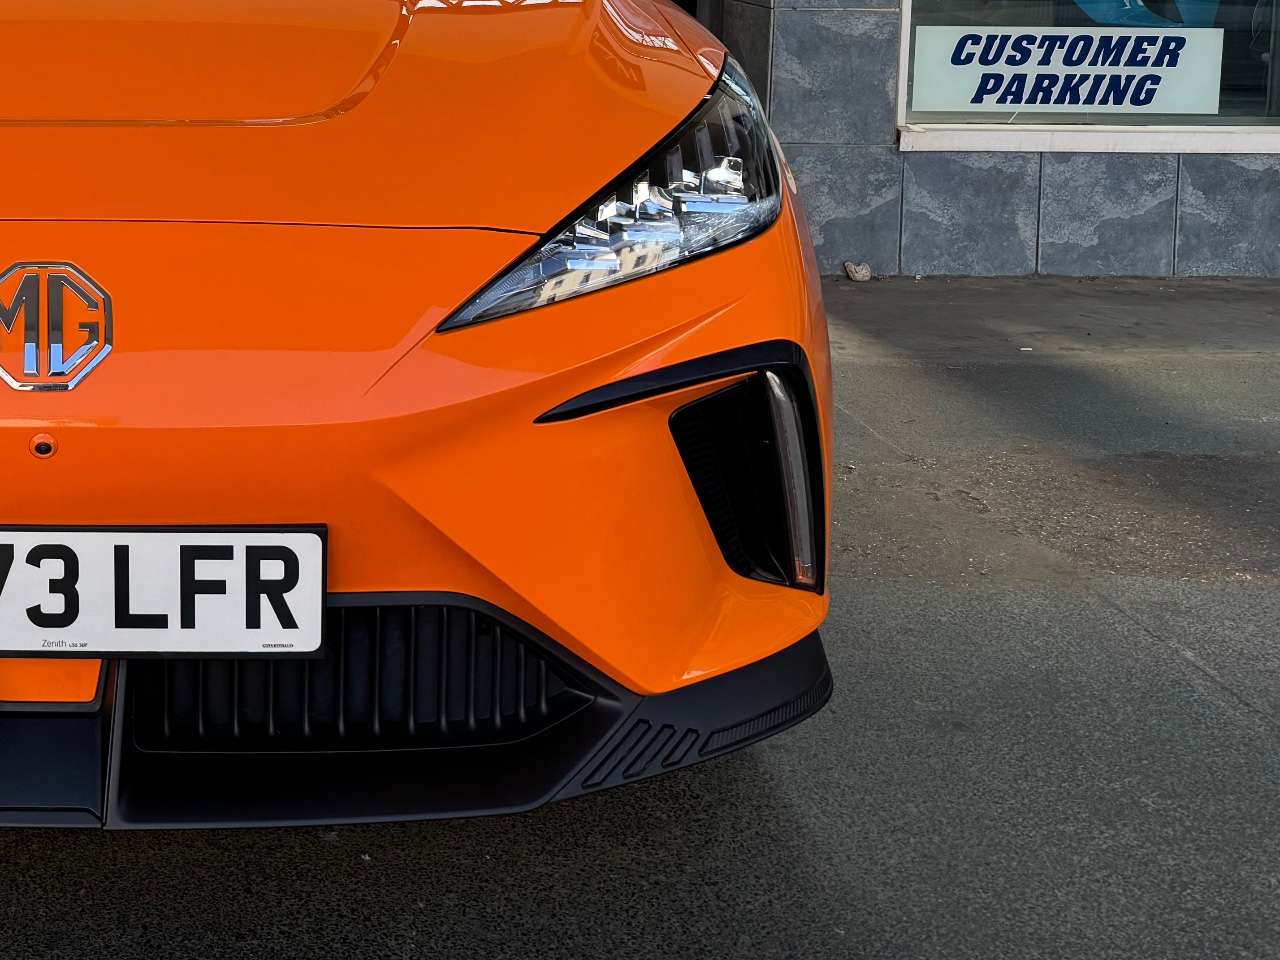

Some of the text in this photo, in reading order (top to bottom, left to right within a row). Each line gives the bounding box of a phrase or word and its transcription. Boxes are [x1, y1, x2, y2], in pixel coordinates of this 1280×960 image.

[950, 33, 1187, 68] CUSTOMER
[969, 73, 1162, 107] PARKING
[113, 544, 300, 630] LFR
[42, 640, 66, 648] Zenith
